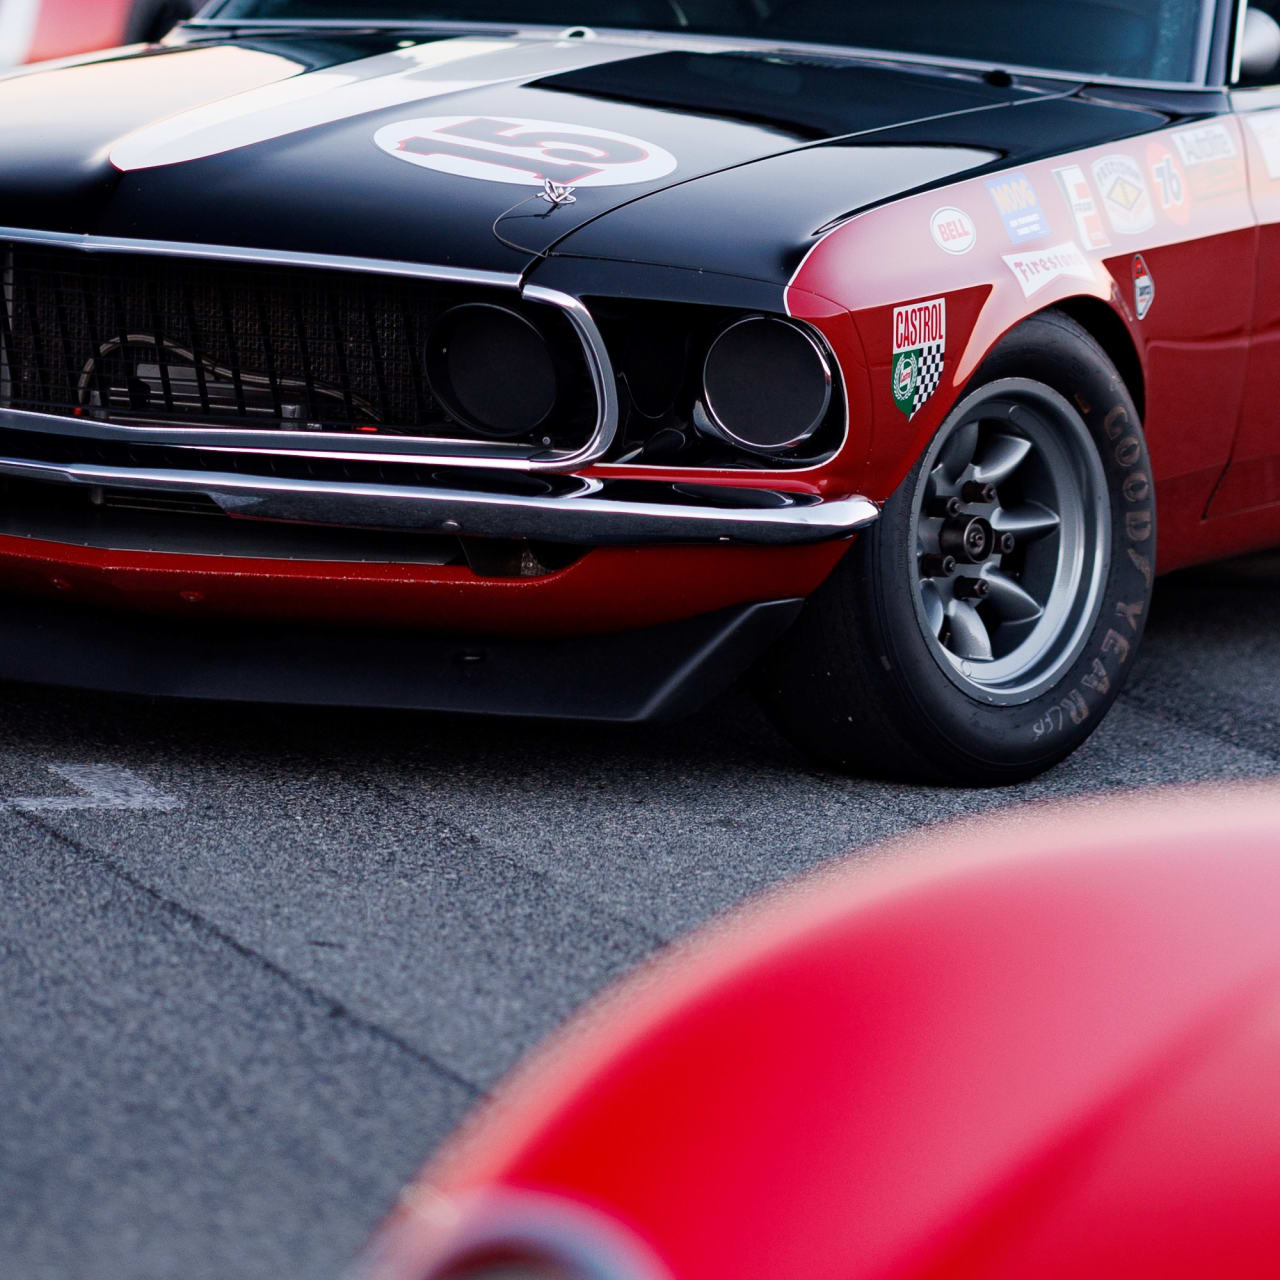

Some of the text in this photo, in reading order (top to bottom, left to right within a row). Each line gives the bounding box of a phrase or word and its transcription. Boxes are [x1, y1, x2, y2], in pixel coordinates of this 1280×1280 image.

[396, 118, 650, 184] 15
[990, 179, 1037, 215] MOOG
[1154, 155, 1184, 207] 76
[937, 218, 970, 242] BELL
[1013, 251, 1083, 283] Firesto
[895, 303, 944, 349] CASTROL
